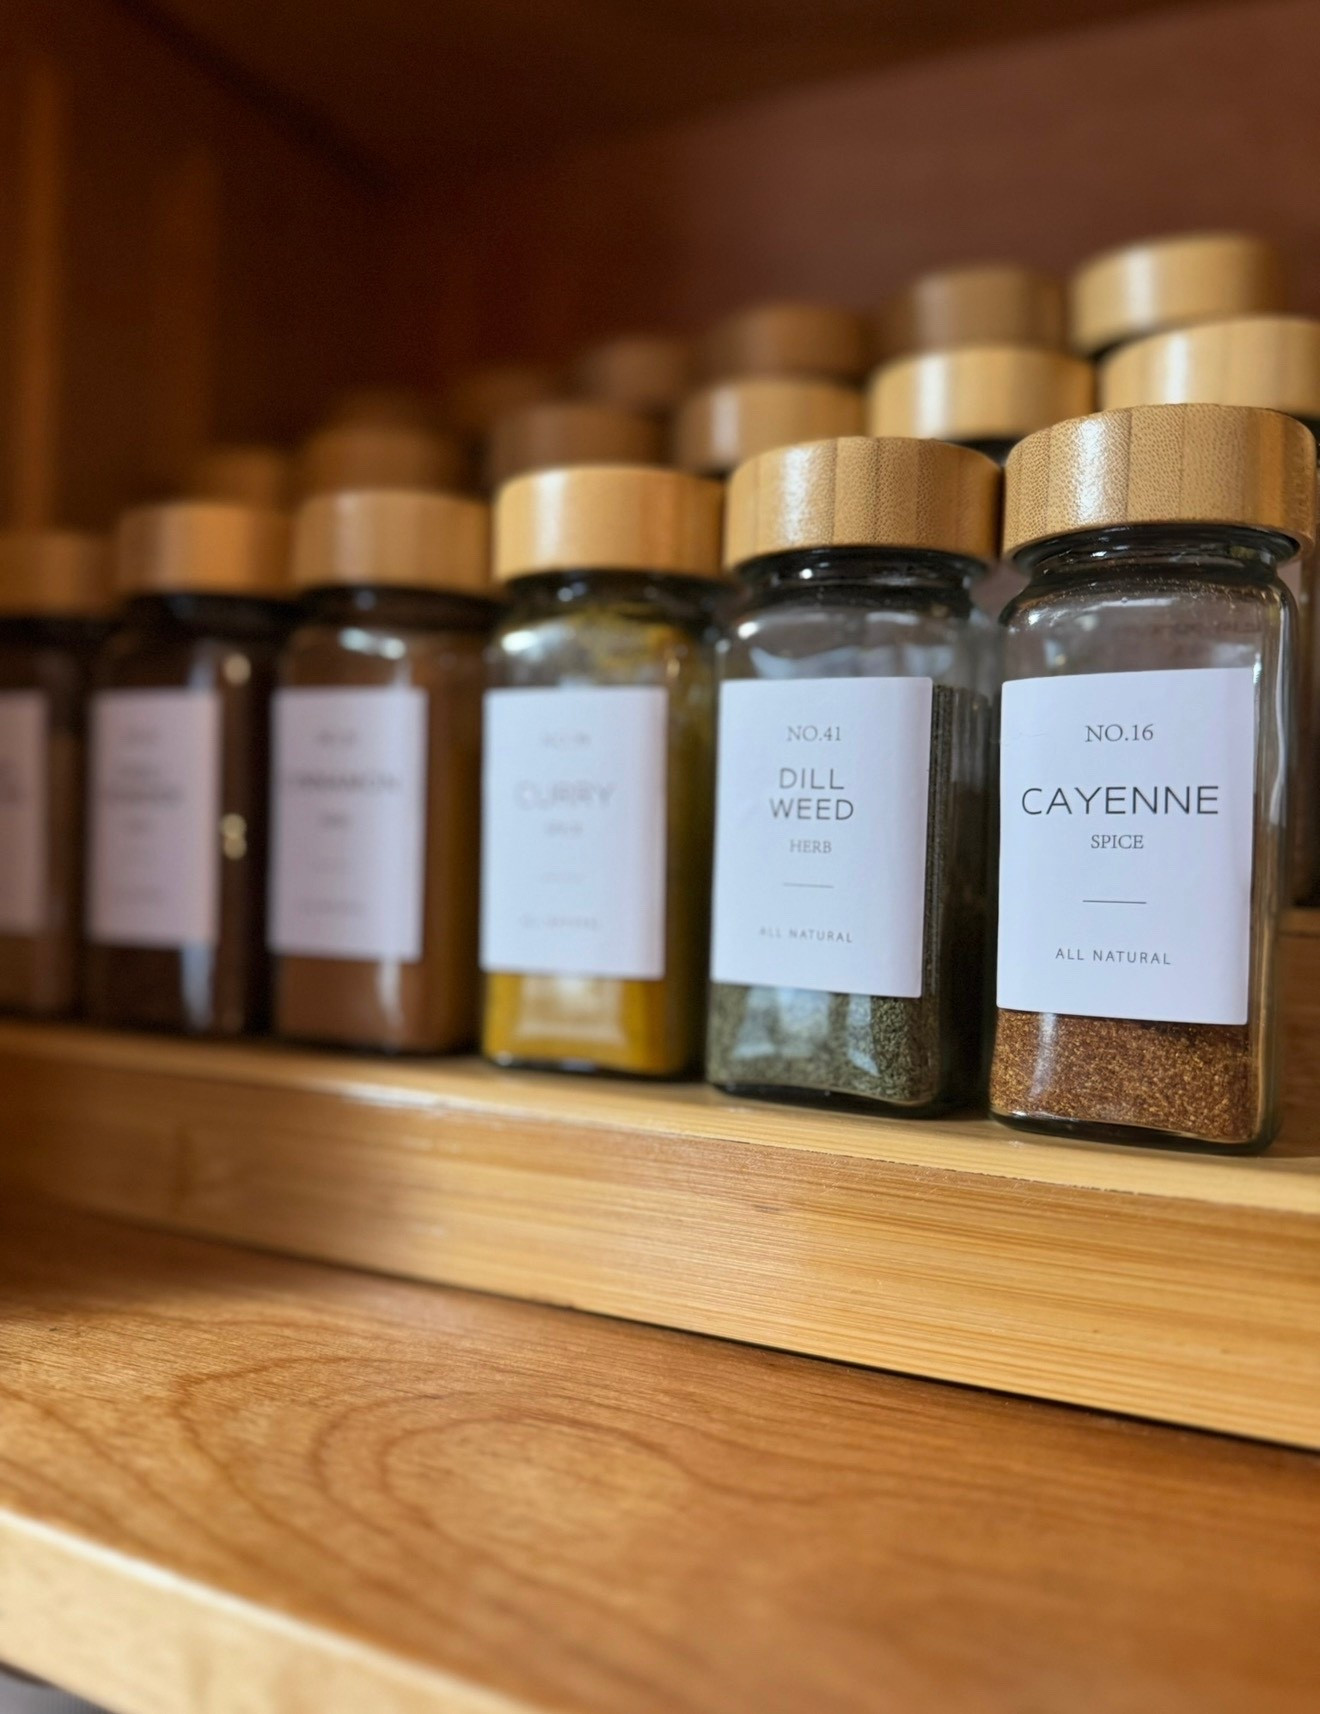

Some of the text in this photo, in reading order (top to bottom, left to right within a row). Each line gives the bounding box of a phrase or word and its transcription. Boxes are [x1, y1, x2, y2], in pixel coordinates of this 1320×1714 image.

[786, 724, 842, 742] NO.41
[1084, 723, 1154, 743] NO.16
[778, 767, 845, 791] DILL
[769, 797, 855, 821] WEED
[1021, 785, 1219, 816] CAYENNE
[789, 838, 833, 855] HERB
[1090, 834, 1144, 850] SPICE
[788, 928, 853, 944] NATURAL
[1055, 947, 1171, 966] ALL NATURAL
